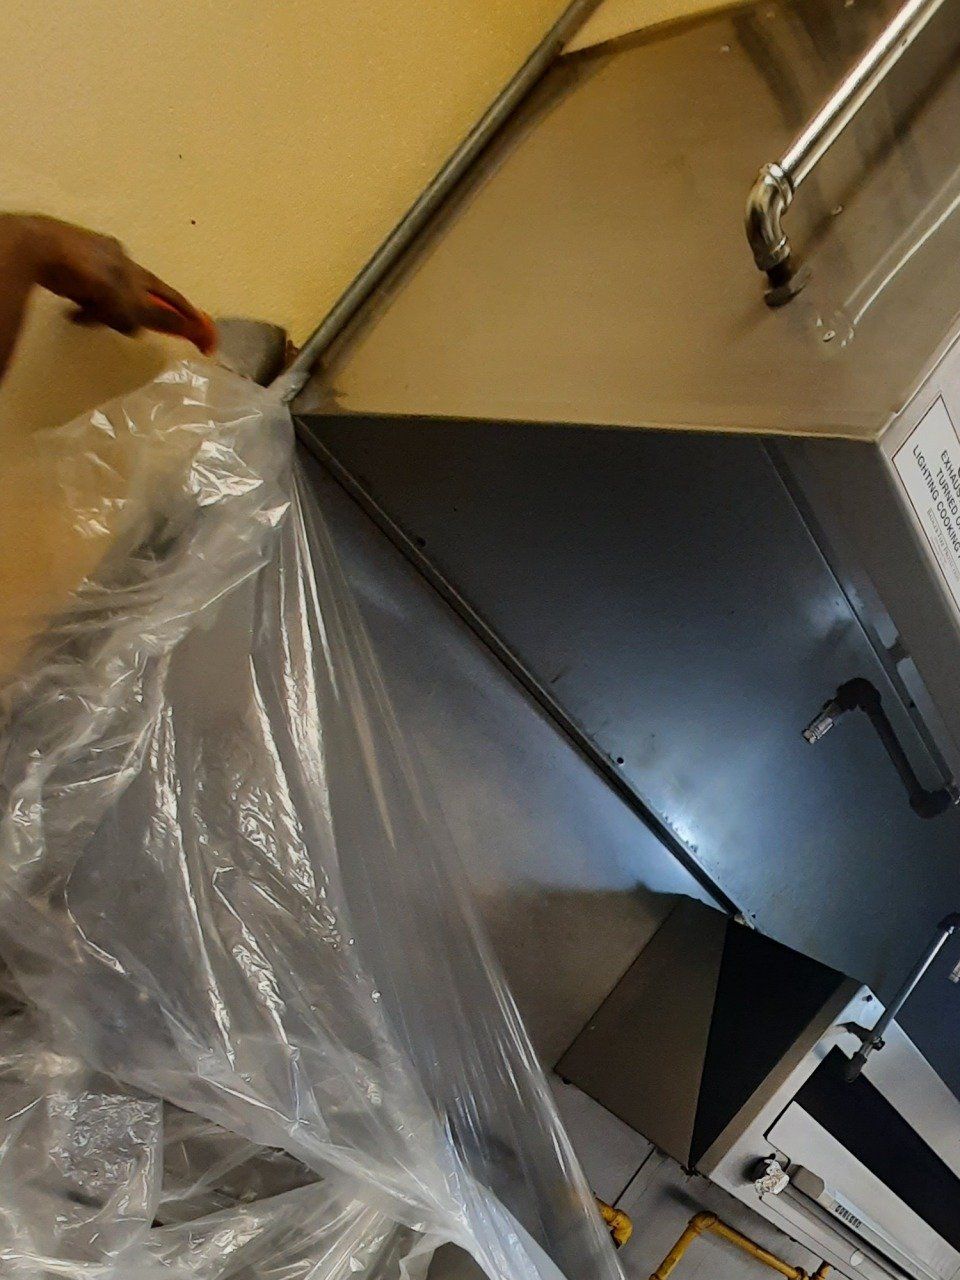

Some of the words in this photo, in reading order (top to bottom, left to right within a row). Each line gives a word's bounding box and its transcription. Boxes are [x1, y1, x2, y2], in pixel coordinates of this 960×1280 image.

[912, 444, 939, 501] LIGHTING
[936, 500, 960, 553] COOKING
[936, 467, 958, 516] TURNED
